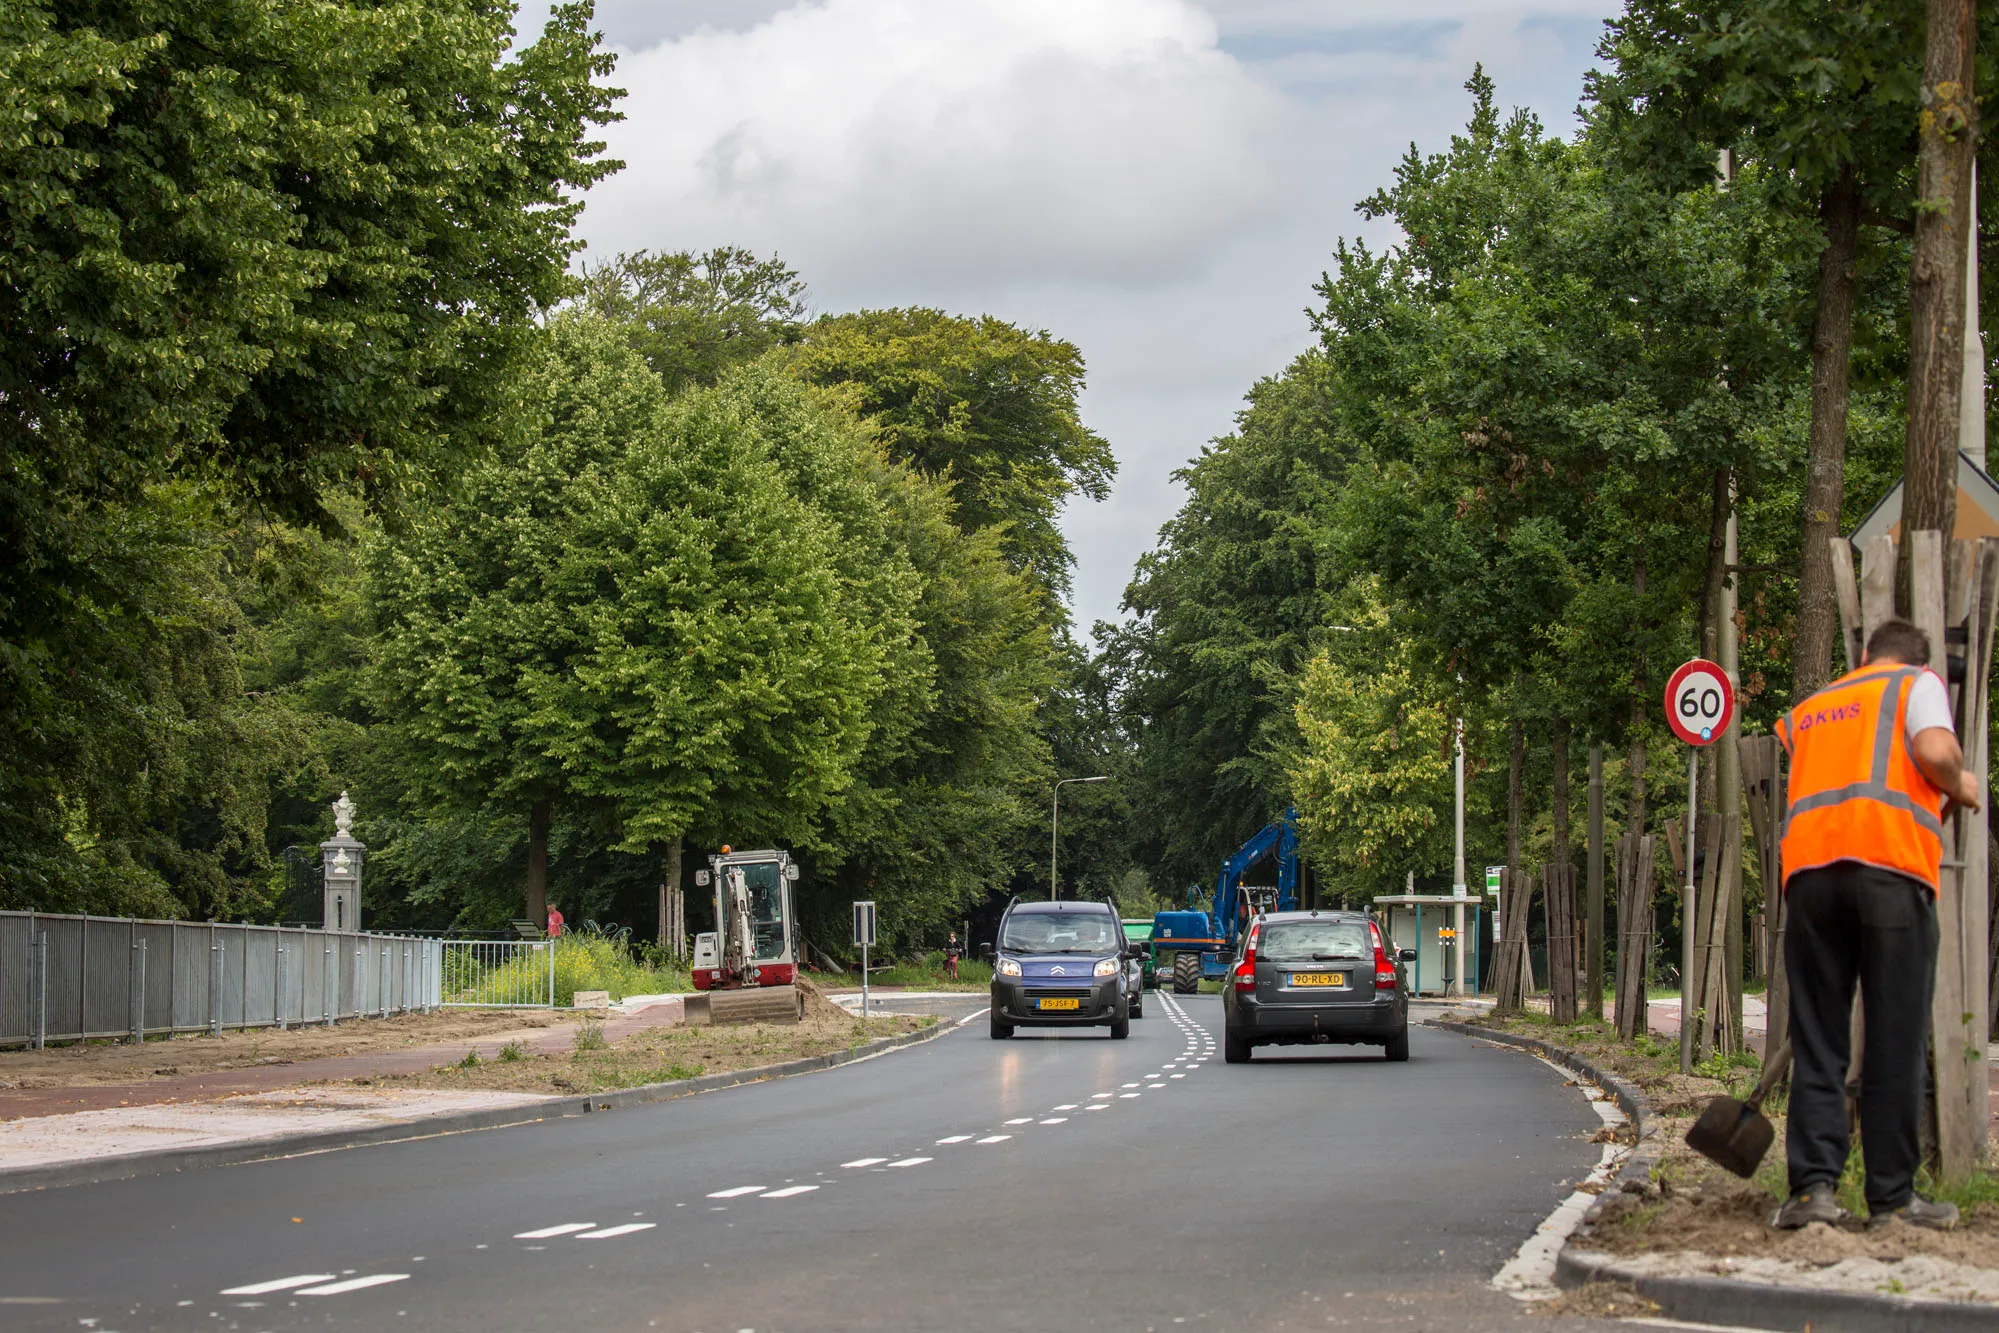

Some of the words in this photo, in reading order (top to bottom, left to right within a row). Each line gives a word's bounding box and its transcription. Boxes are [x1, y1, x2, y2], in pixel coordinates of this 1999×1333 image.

[1680, 688, 1720, 718] 60
[1815, 702, 1861, 725] KWS
[1294, 975, 1340, 984] 90-RL-XD
